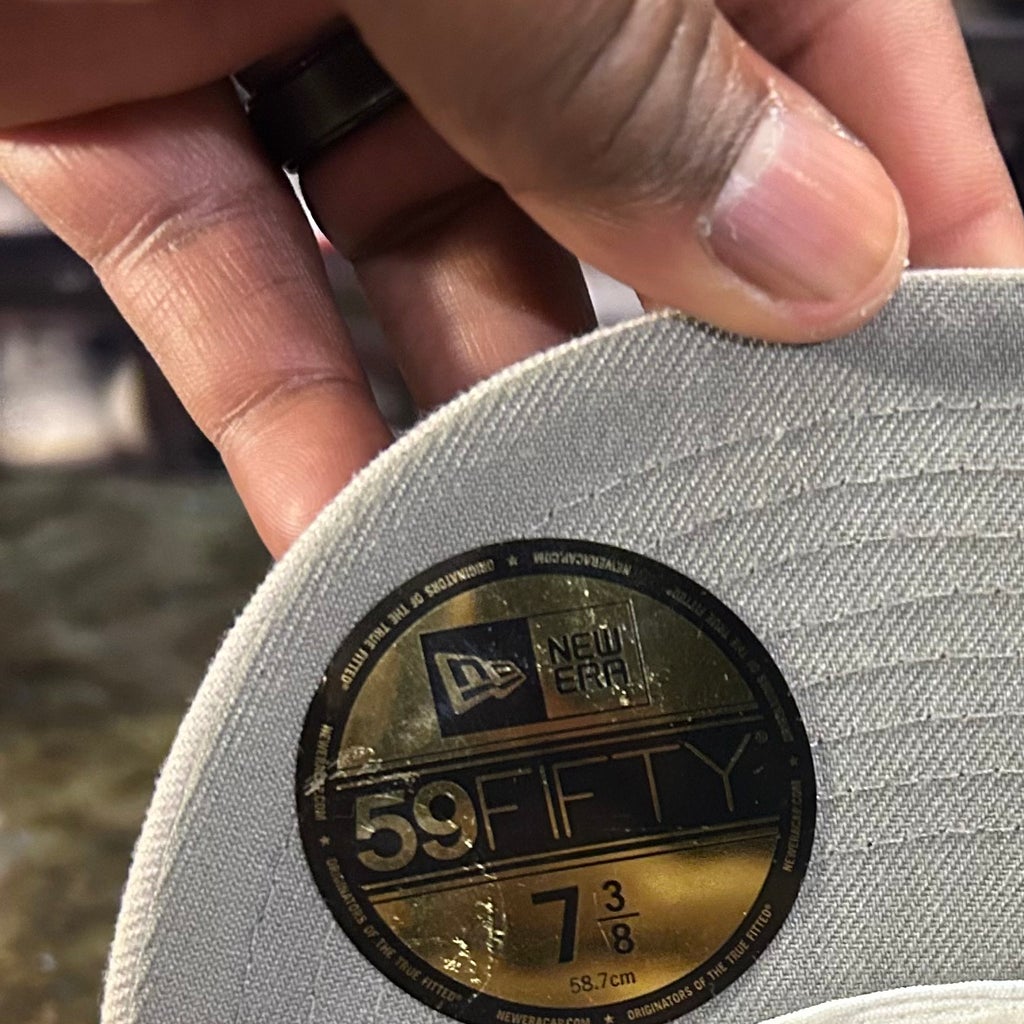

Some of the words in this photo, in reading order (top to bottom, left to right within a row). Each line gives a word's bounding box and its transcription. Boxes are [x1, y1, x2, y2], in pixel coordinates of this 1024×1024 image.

[386, 603, 410, 626] THE
[408, 591, 425, 608] OF
[363, 622, 391, 650] TRUE
[547, 626, 625, 665] NEW
[553, 658, 631, 695] ERA
[531, 886, 579, 964] 7
[362, 924, 379, 940] OF
[374, 935, 396, 959] THE
[394, 956, 423, 981] TRUE
[569, 970, 636, 994] 58.7cm
[626, 985, 694, 1022] ORIGINATORS
[693, 976, 708, 991] OF
[706, 961, 728, 983] THE
[726, 939, 751, 966] TRUE
